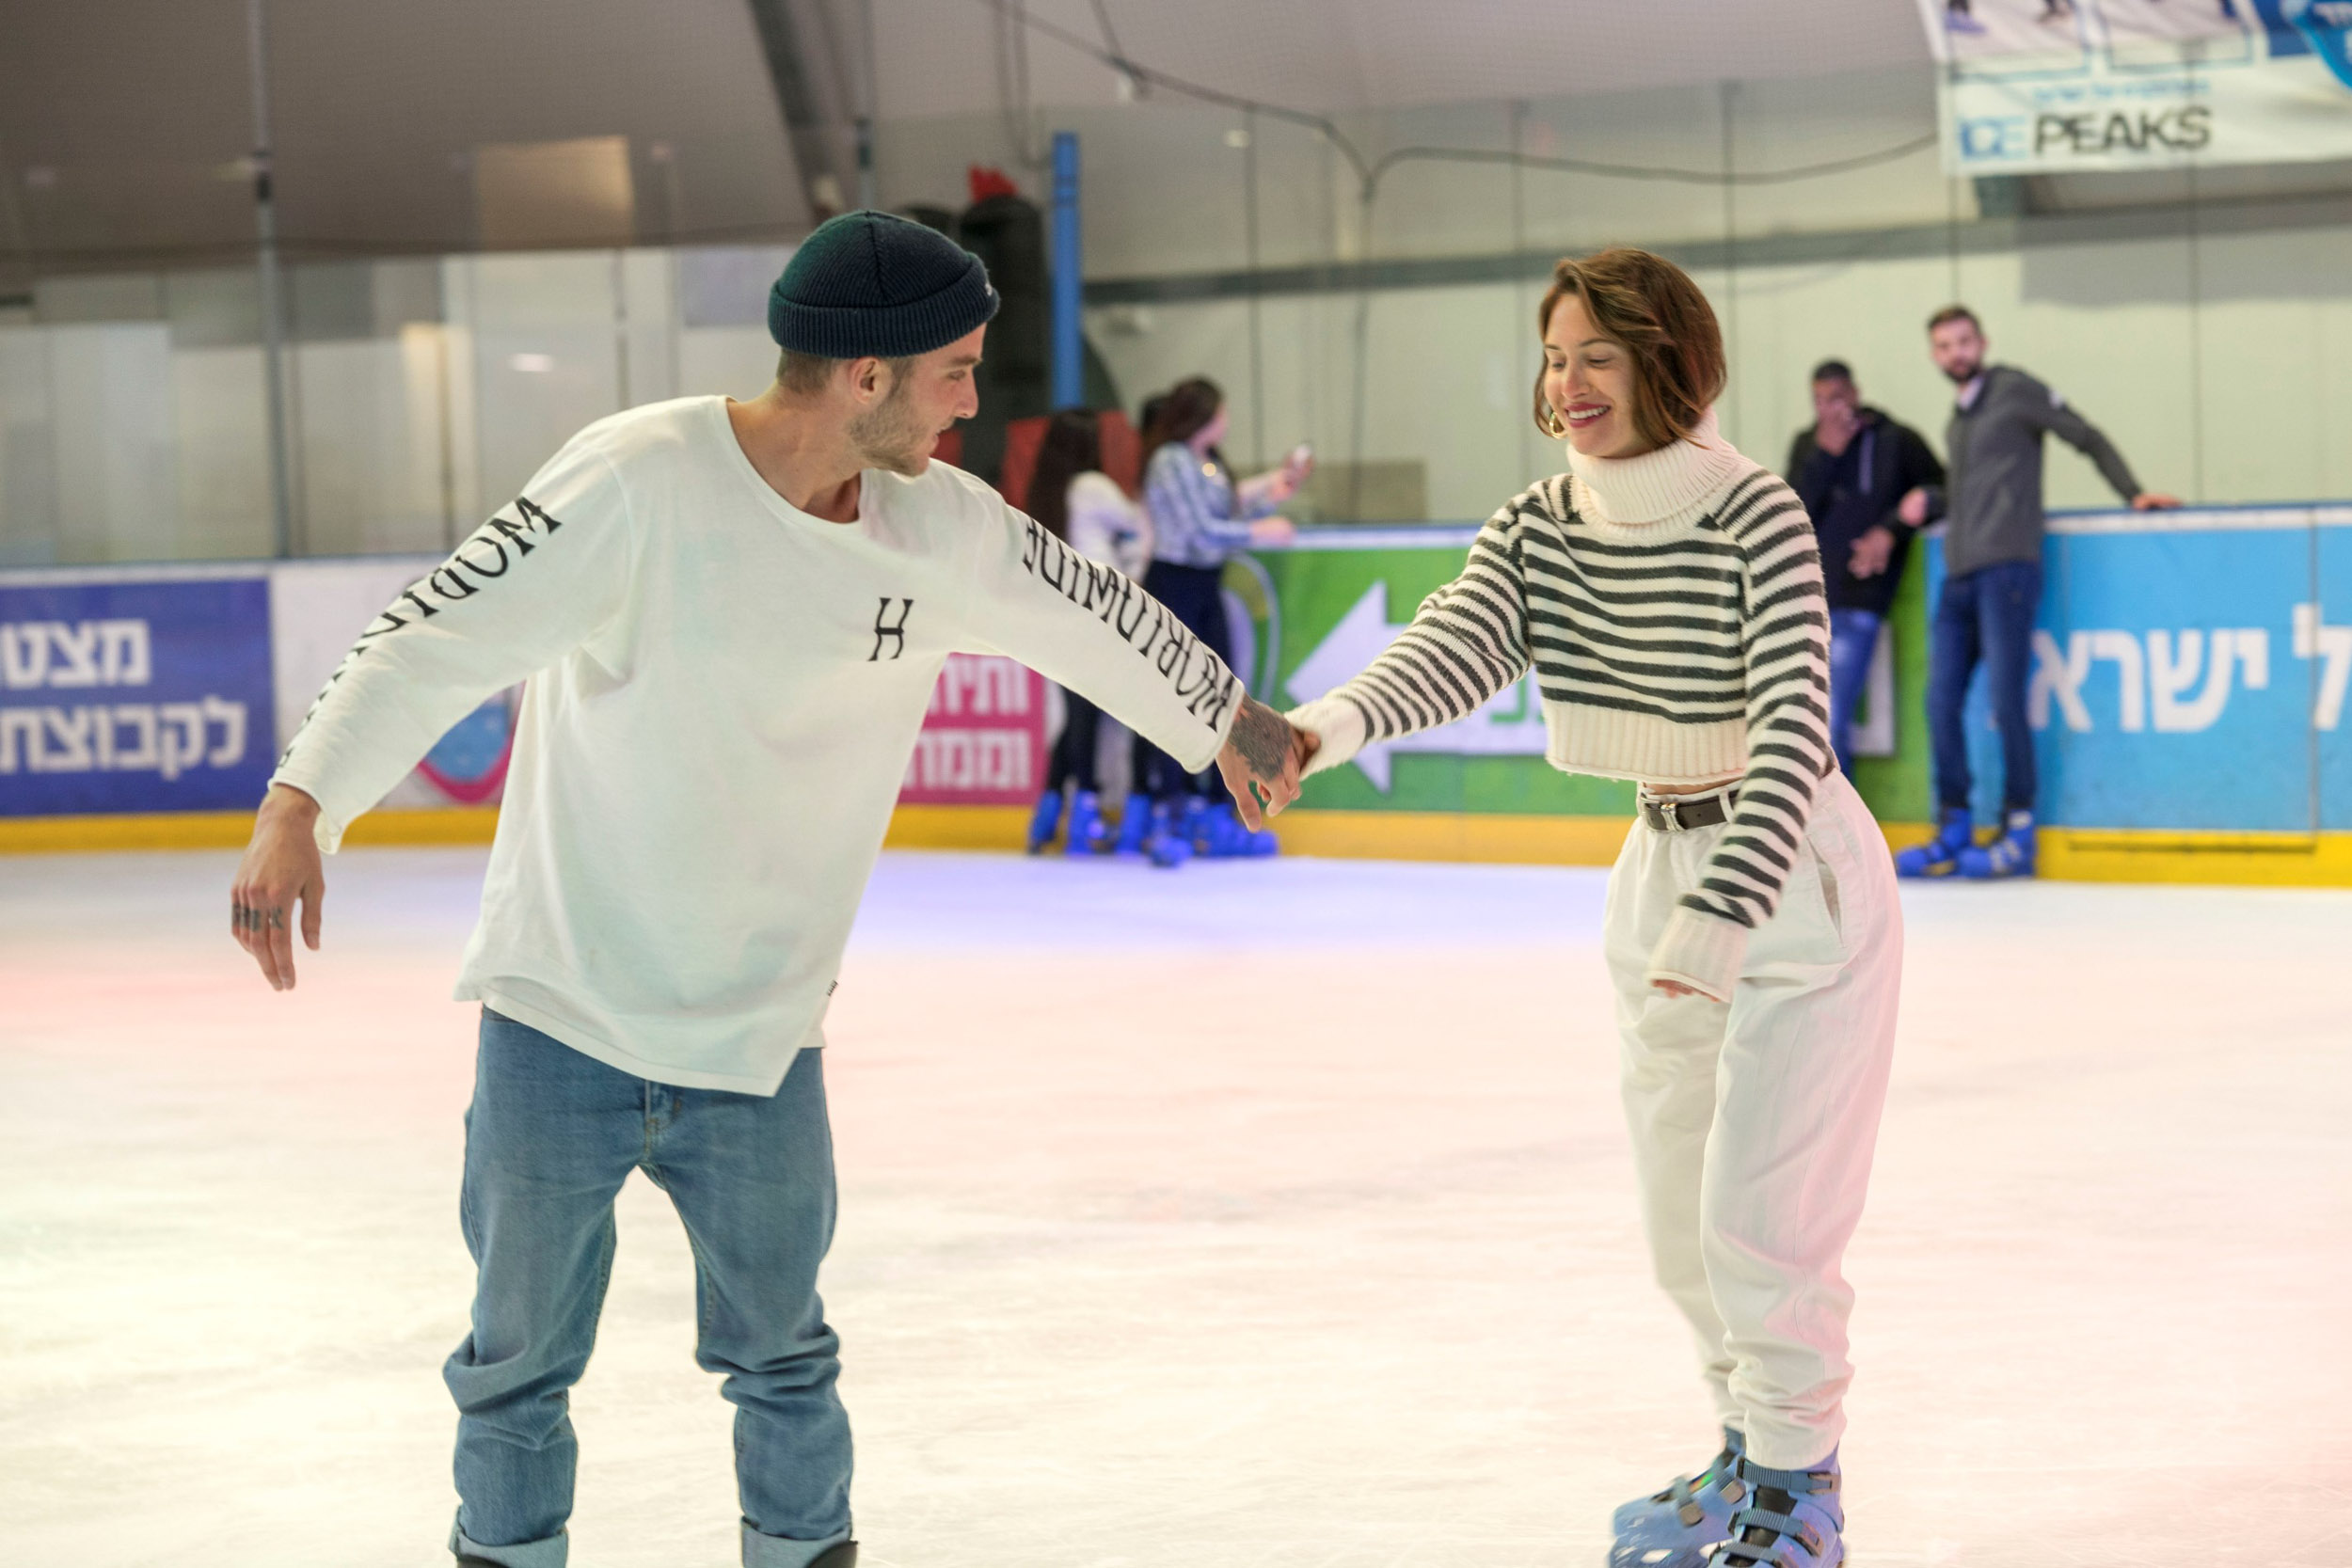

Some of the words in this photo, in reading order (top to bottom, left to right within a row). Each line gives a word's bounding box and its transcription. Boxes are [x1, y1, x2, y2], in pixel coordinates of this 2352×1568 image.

[2035, 104, 2212, 155] PEAKS
[867, 597, 914, 661] H
[1987, 628, 2269, 734] ישרא
